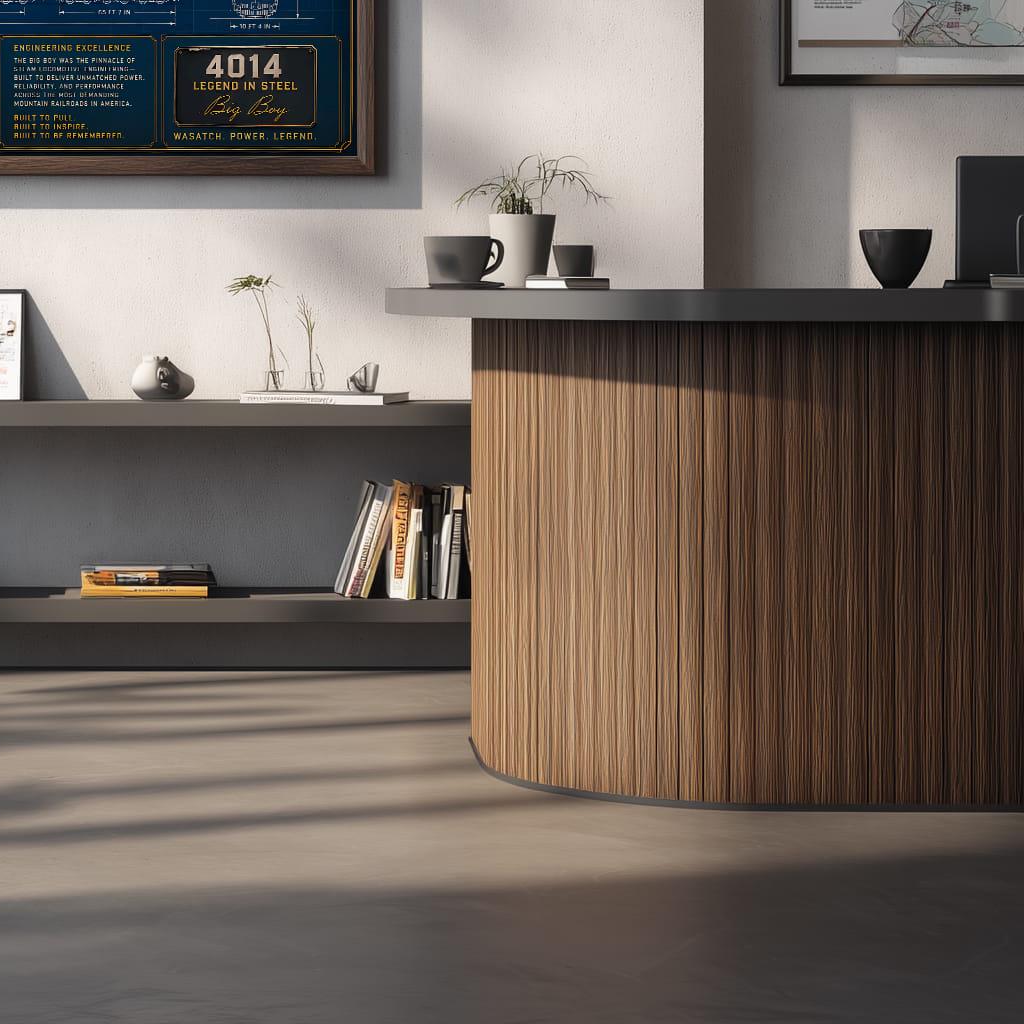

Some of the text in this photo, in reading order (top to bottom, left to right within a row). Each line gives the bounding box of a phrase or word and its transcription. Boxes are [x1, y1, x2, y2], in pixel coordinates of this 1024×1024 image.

[205, 54, 282, 79] 4014
[194, 82, 298, 91] LEGEND IN STEEL
[201, 95, 288, 122] Big Boy
[230, 132, 269, 140] POWER.
